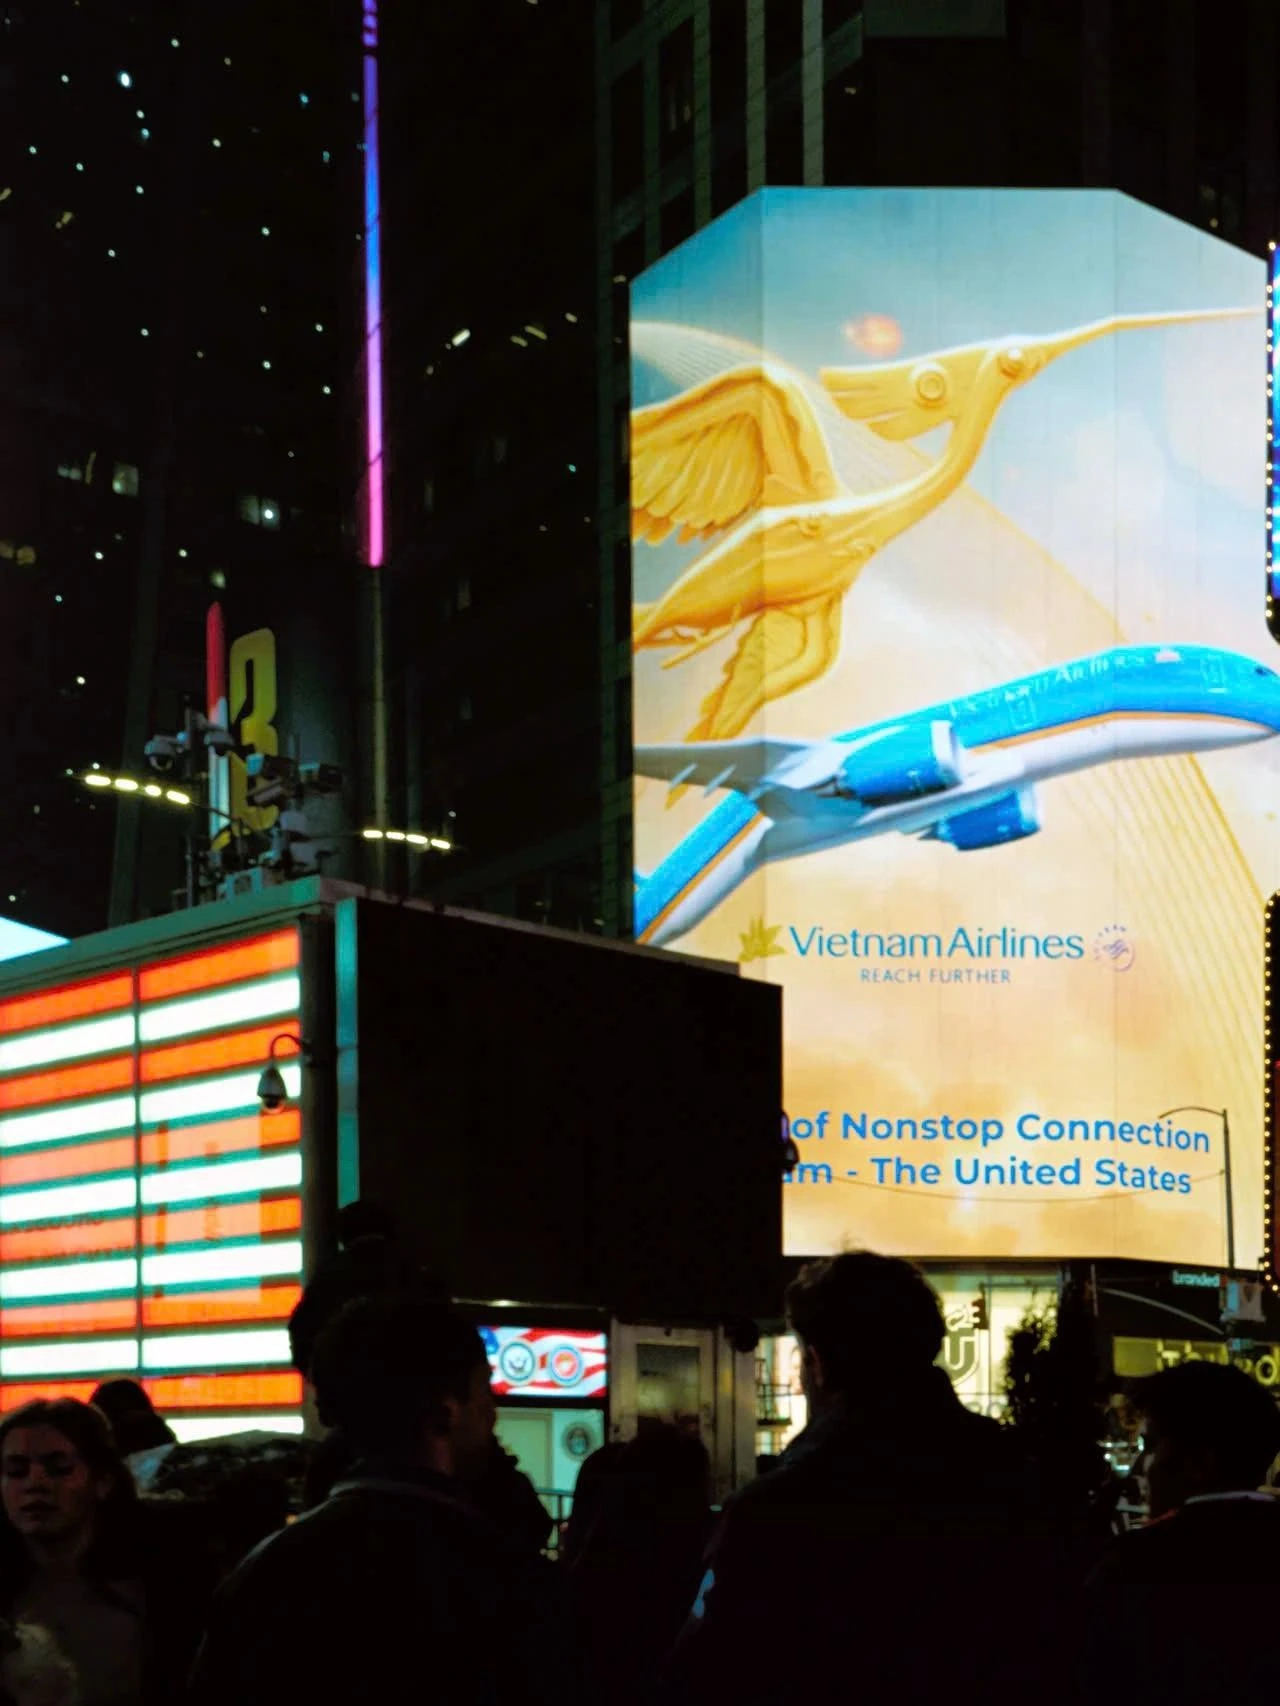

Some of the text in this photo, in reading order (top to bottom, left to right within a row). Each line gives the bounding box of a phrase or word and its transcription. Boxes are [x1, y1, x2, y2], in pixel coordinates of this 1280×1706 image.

[788, 926, 941, 958] Vietnam
[946, 926, 1085, 960] Airlines
[860, 968, 1011, 984] REACH FURTHER
[791, 1111, 1210, 1153] of Nonstop Connection
[869, 1156, 941, 1185] The
[954, 1155, 1081, 1185] United
[1095, 1158, 1192, 1194] States
